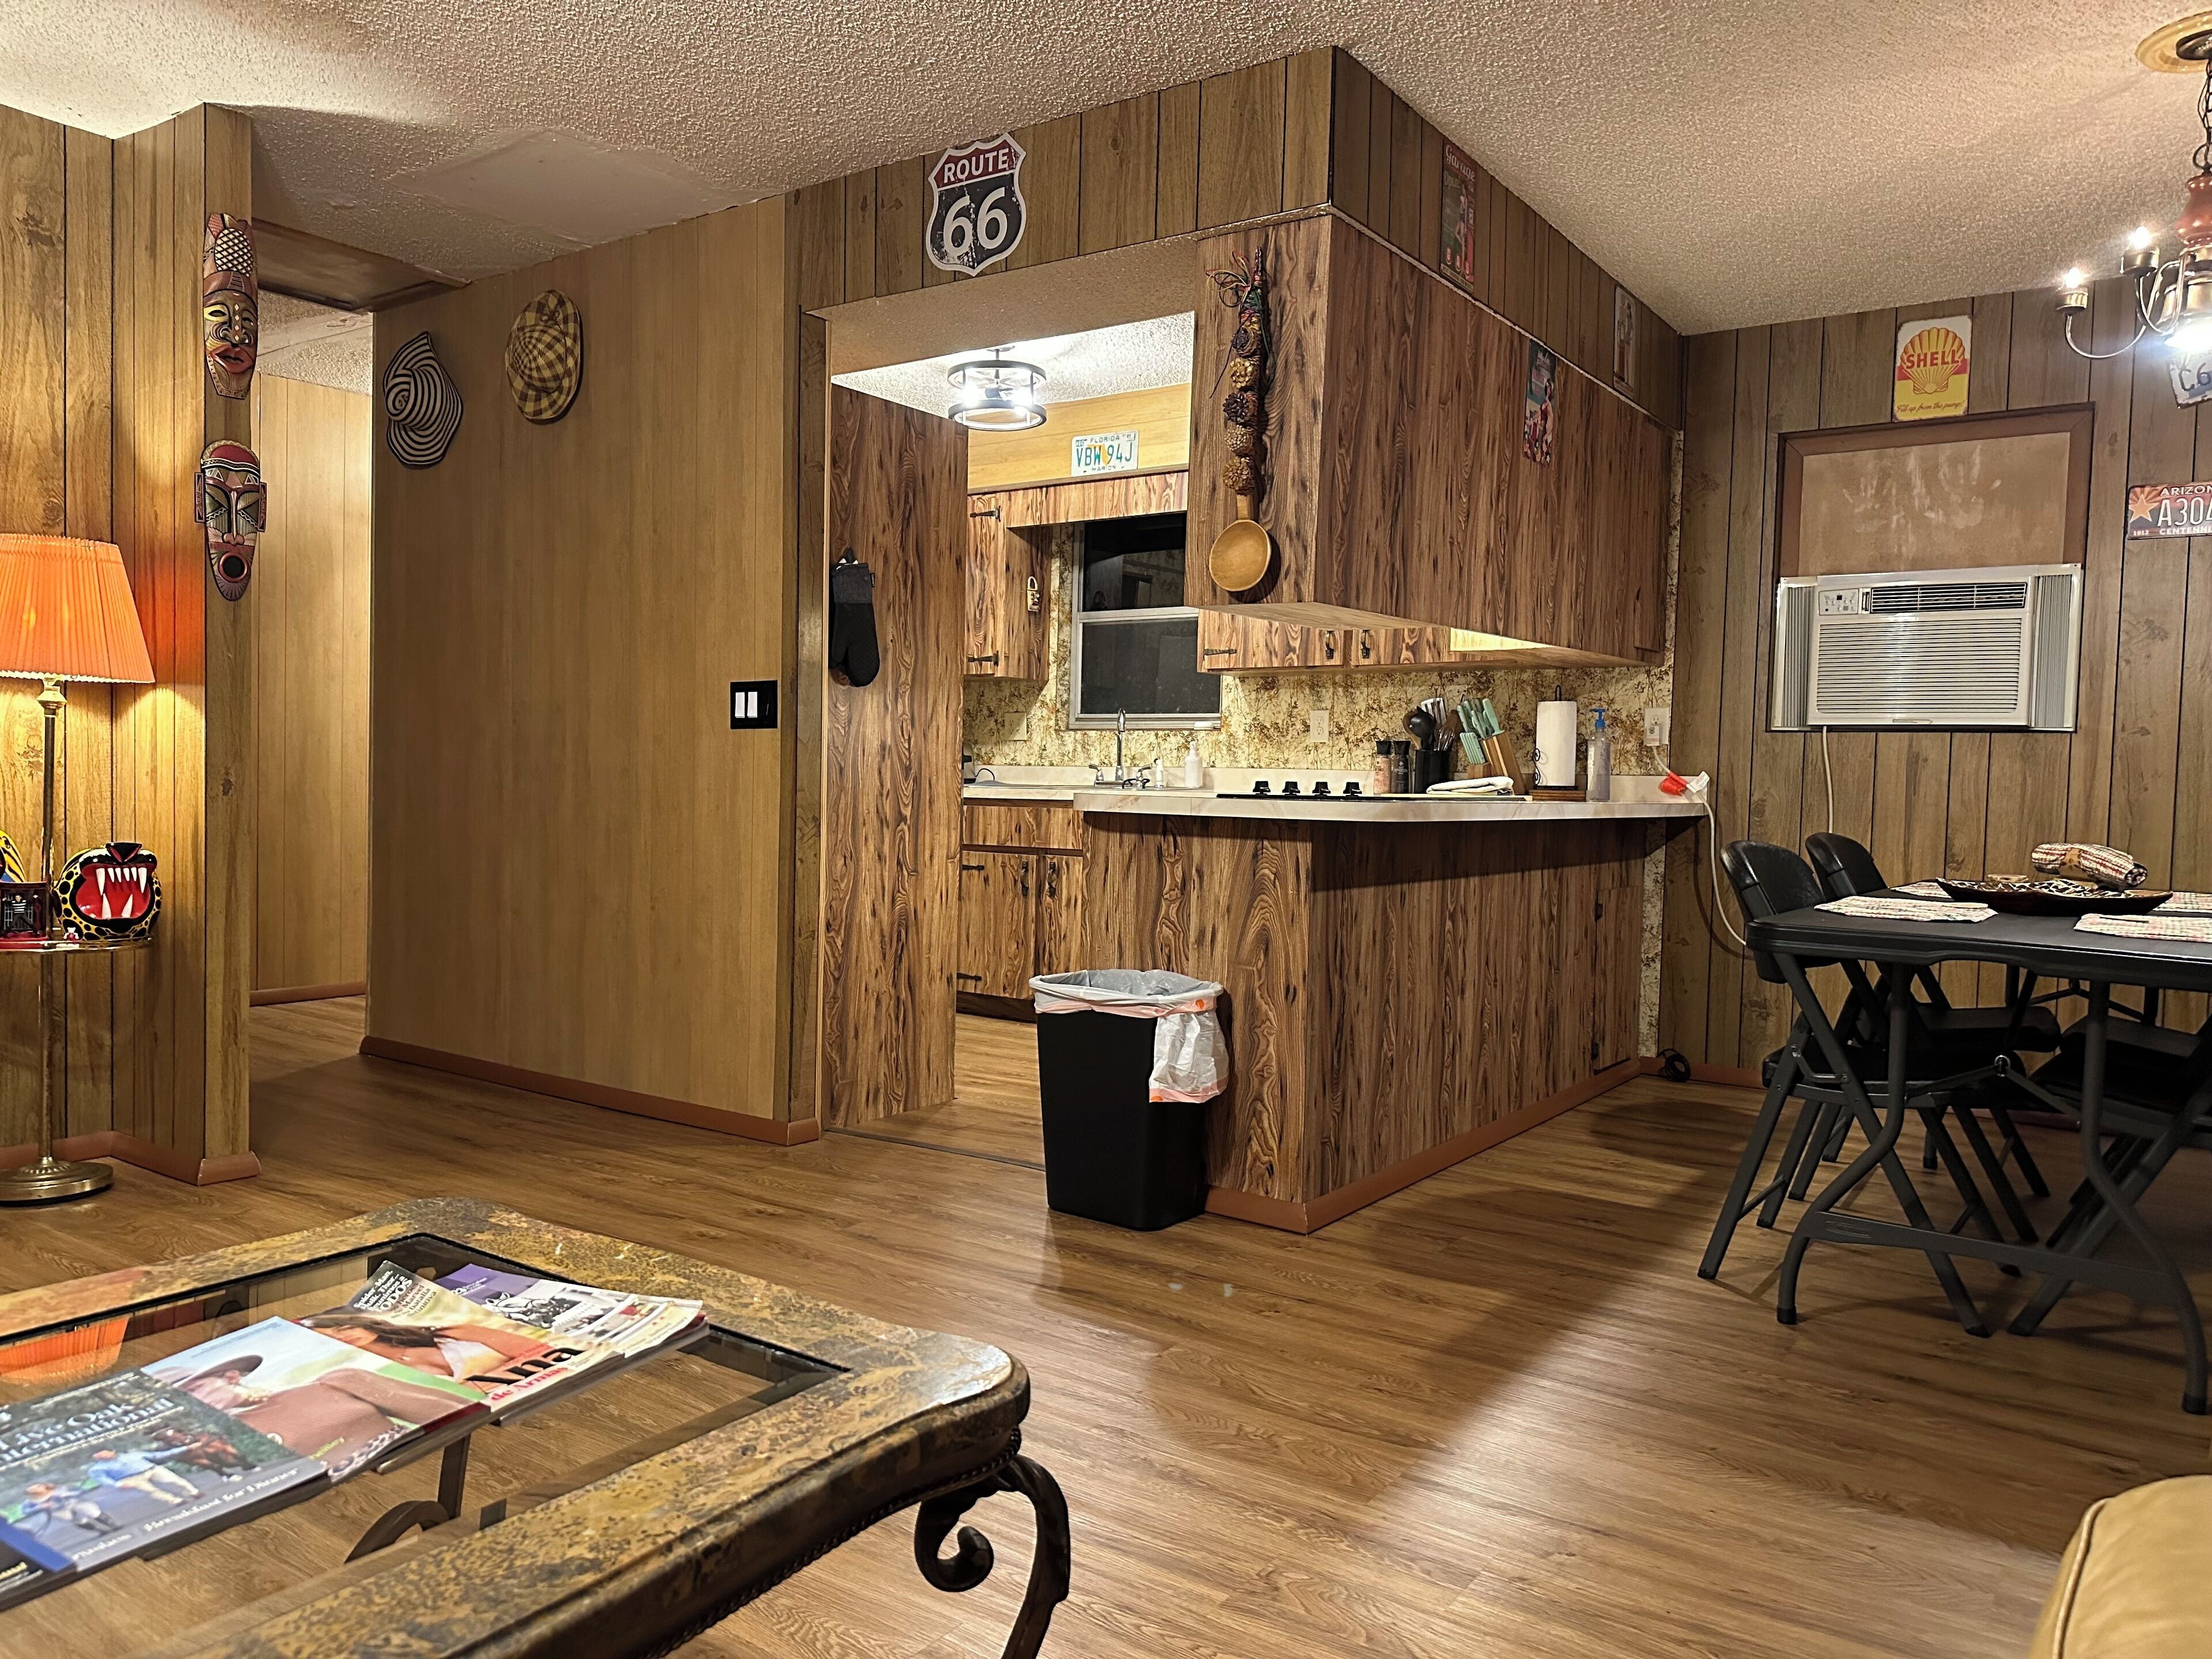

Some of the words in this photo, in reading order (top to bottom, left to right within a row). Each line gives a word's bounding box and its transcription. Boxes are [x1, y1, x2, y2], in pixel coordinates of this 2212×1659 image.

[944, 148, 1009, 184] ROUTE
[1445, 145, 1475, 181] Garage
[944, 187, 1007, 256] 66
[1906, 349, 1959, 369] SHELL
[1090, 435, 1120, 443] FLORIDA
[1076, 445, 1102, 467] VBW
[1107, 442, 1133, 464] 94J
[402, 1285, 425, 1308] Marvel
[409, 1288, 431, 1310] batalla
[491, 1389, 513, 1401] de
[513, 1366, 568, 1392] Armas
[67, 1404, 135, 1427] Oak
